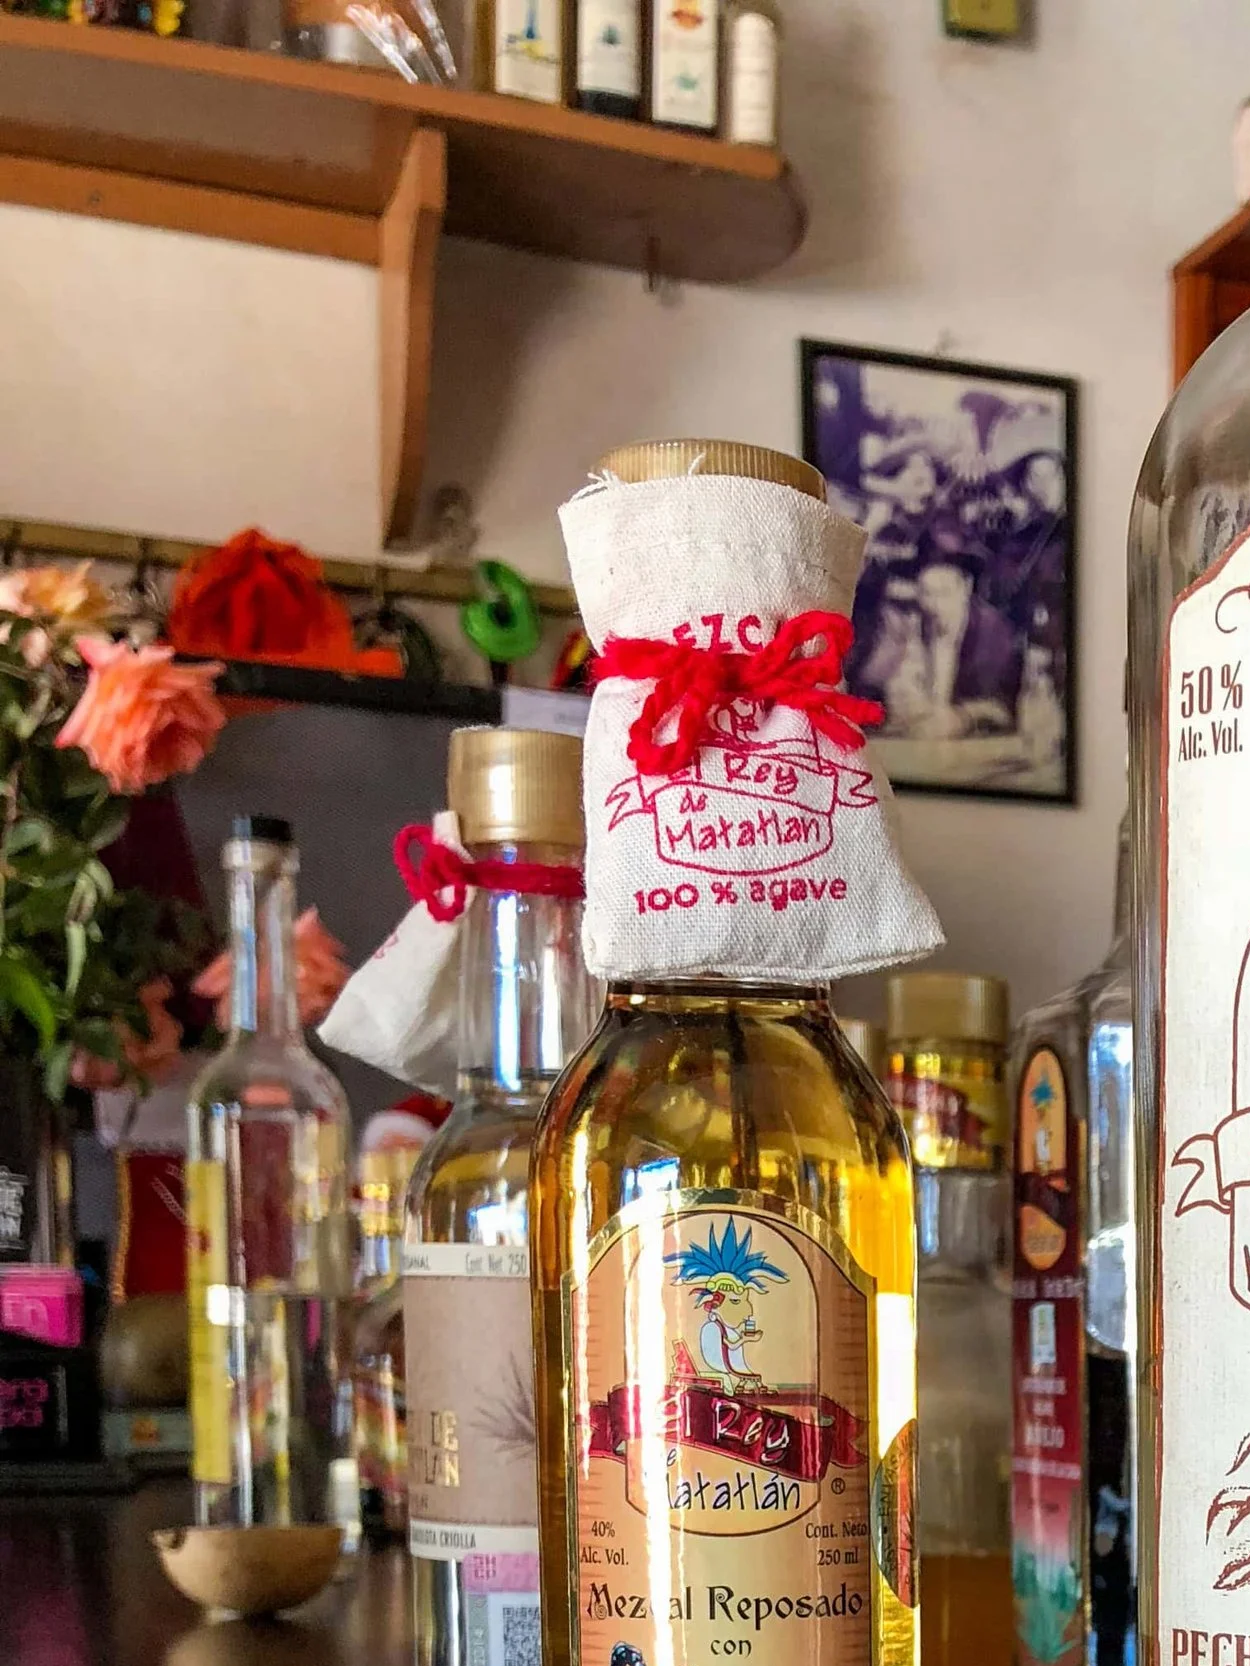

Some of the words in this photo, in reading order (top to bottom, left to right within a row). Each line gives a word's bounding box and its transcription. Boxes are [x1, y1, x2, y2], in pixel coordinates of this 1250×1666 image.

[1178, 725, 1207, 762] Alc.
[1210, 717, 1243, 756] Vol.
[724, 752, 798, 795] Rey
[679, 791, 707, 814] de
[666, 809, 820, 853] Matatlan
[633, 883, 699, 915] 100
[712, 882, 738, 904] %
[750, 877, 847, 911] agave
[713, 1397, 791, 1466] Rey
[591, 1520, 616, 1538] 40%
[805, 1522, 839, 1540] Cont.
[842, 1521, 869, 1539] Neto
[580, 1546, 603, 1565] Alc.
[605, 1547, 630, 1567] Vol.
[817, 1548, 841, 1567] 250
[844, 1547, 860, 1566] ml
[587, 1582, 693, 1622] Mezal
[706, 1582, 863, 1632] Reposado
[709, 1637, 753, 1659] con
